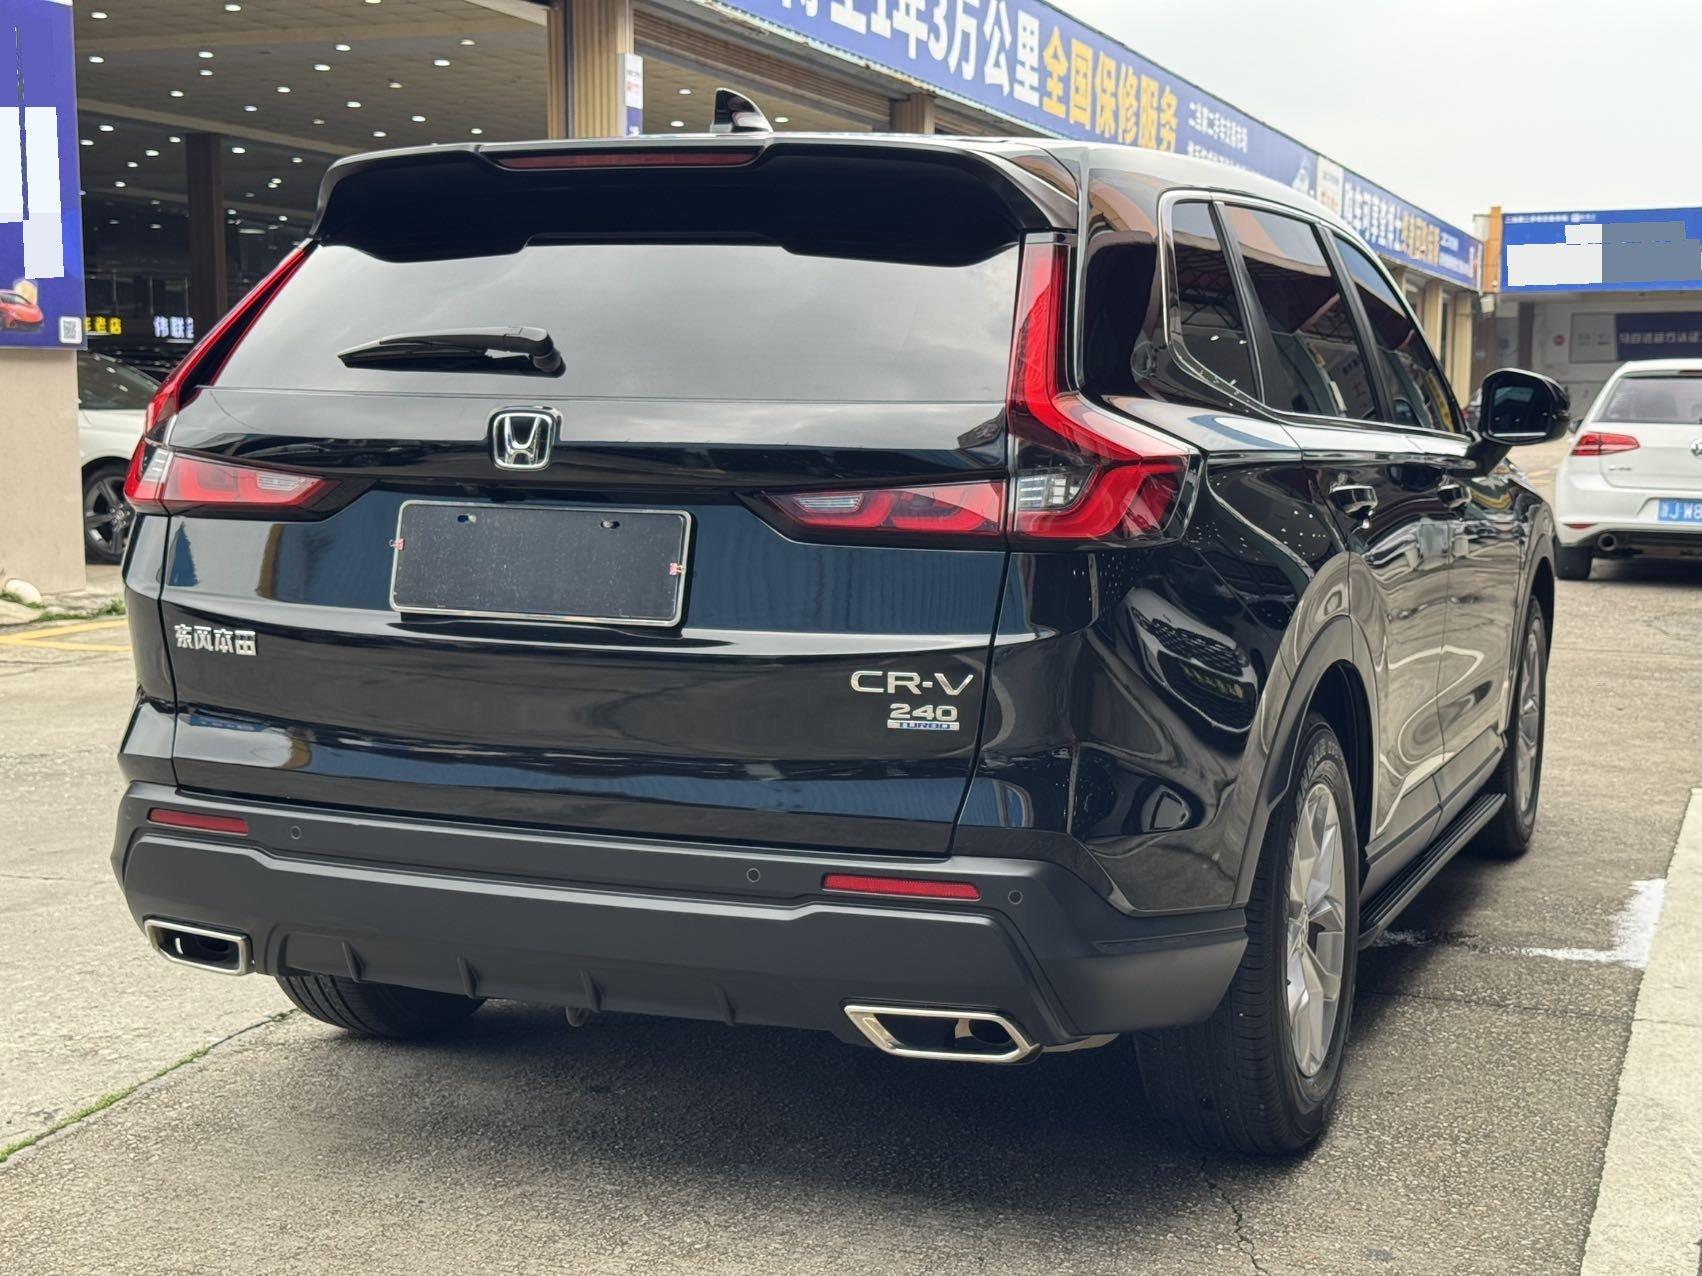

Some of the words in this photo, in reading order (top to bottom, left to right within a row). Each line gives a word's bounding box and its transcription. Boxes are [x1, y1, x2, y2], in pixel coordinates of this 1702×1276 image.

[782, 0, 1179, 152] 年3万公里全国保修服务
[174, 624, 256, 656] 东风本田
[850, 670, 974, 696] CR-V
[889, 703, 958, 721] 240
[897, 721, 952, 730] TURBO
